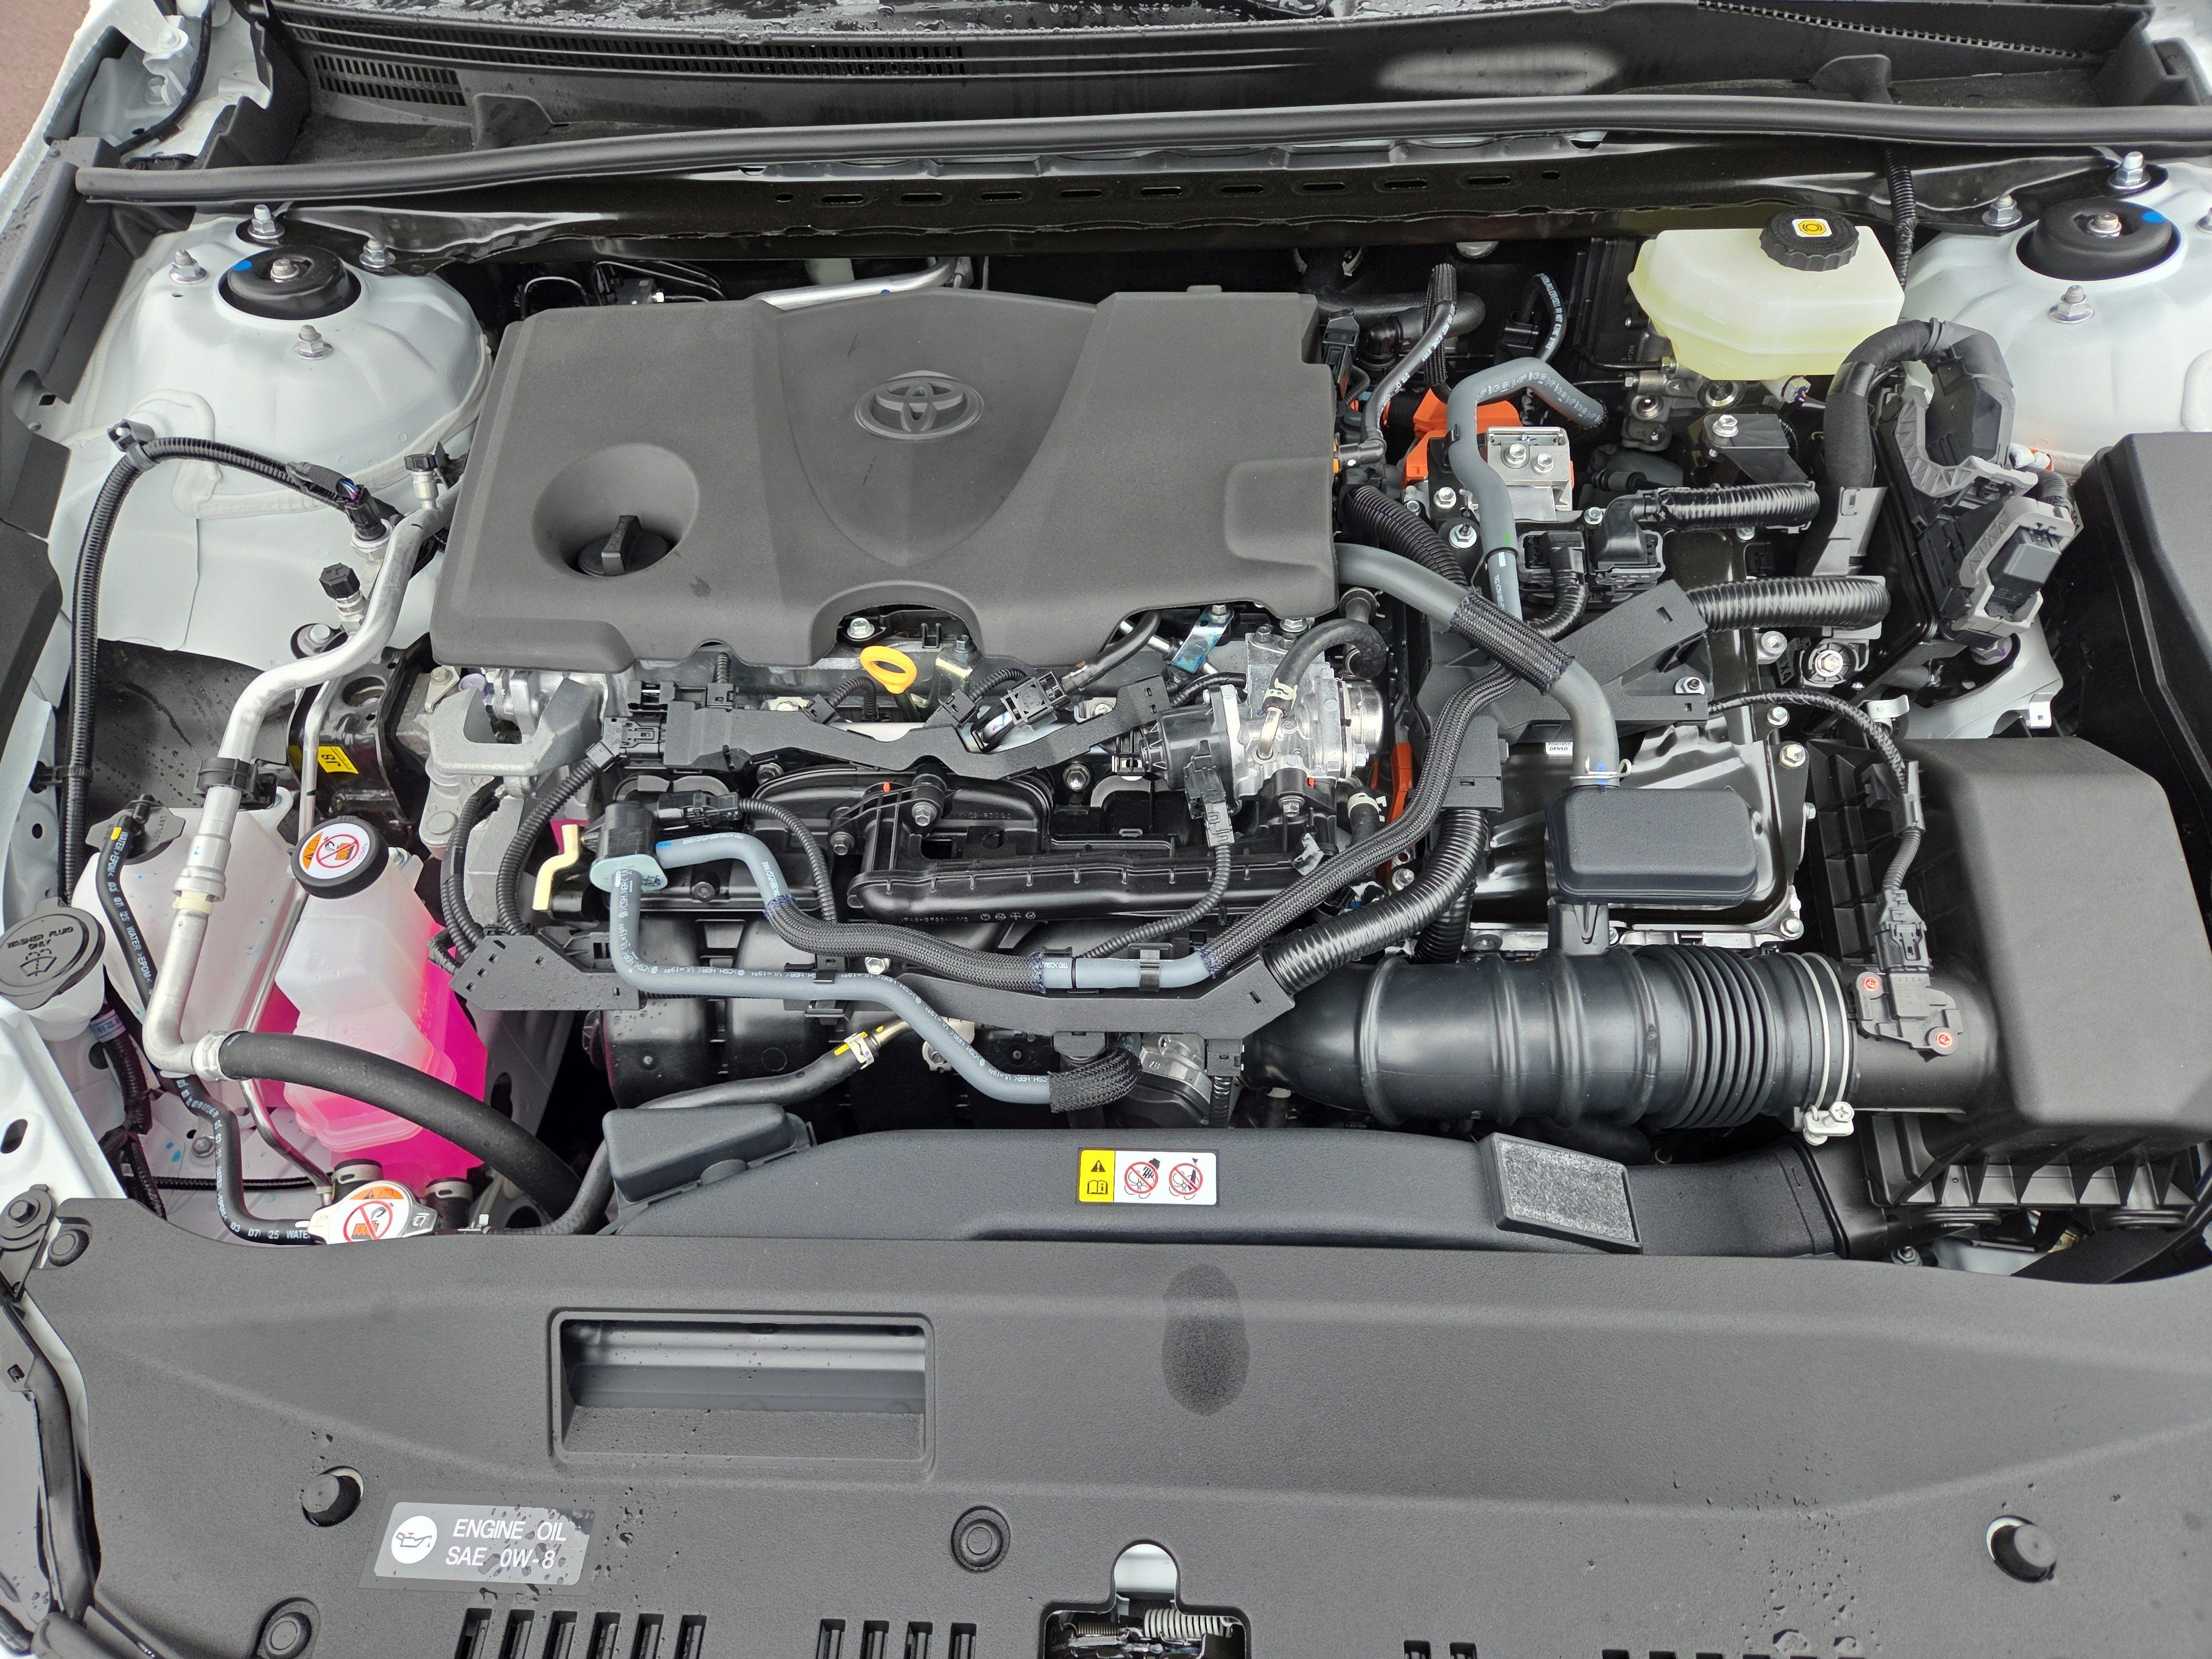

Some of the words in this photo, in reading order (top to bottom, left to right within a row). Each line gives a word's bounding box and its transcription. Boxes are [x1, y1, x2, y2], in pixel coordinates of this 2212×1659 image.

[7, 934, 44, 949] WASHER
[49, 926, 74, 938] FLUID
[28, 938, 51, 950] ONLY
[126, 925, 142, 951] WATER
[286, 1229, 310, 1239] WATE
[453, 1518, 526, 1540] ENGINE
[537, 1521, 568, 1542] OIL
[445, 1546, 488, 1567] SAE
[499, 1547, 556, 1570] 0W-8
